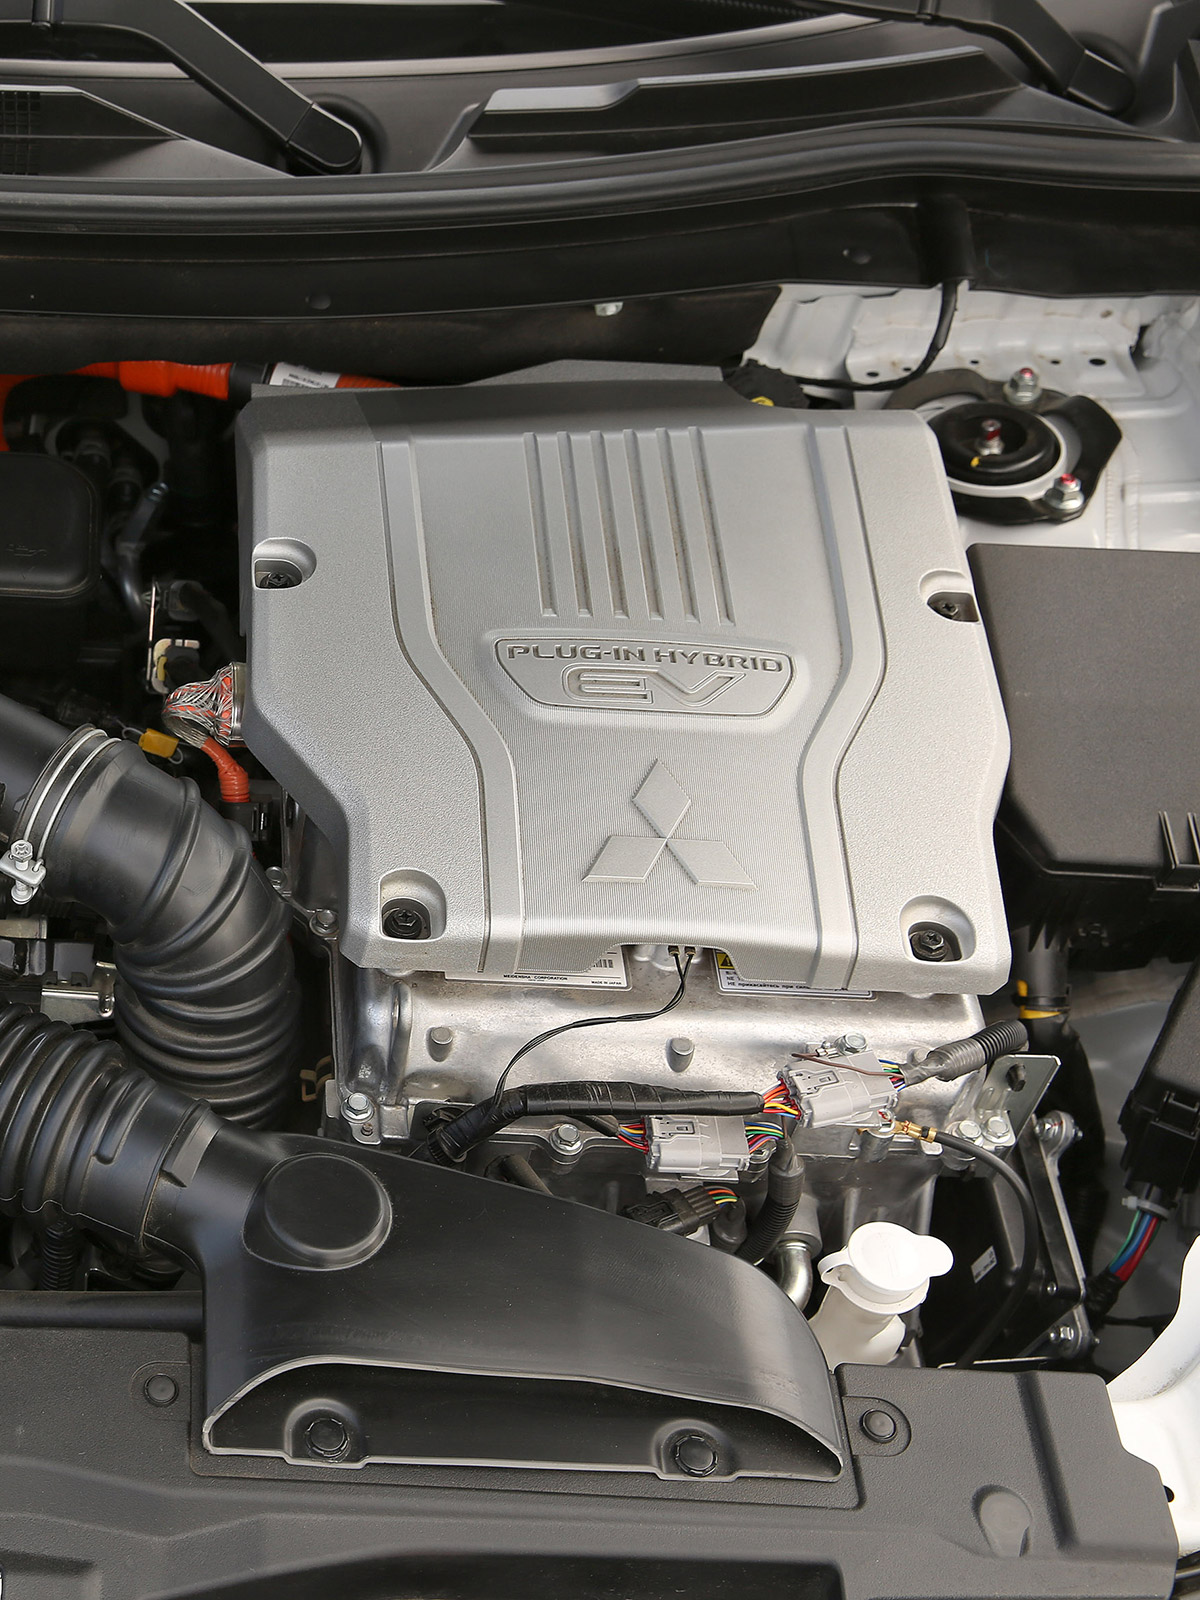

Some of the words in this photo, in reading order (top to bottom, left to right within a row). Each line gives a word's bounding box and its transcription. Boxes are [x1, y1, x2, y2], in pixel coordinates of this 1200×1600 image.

[506, 643, 646, 662] PLUG-IN
[654, 647, 783, 673] HYBRID
[561, 662, 747, 707] EV
